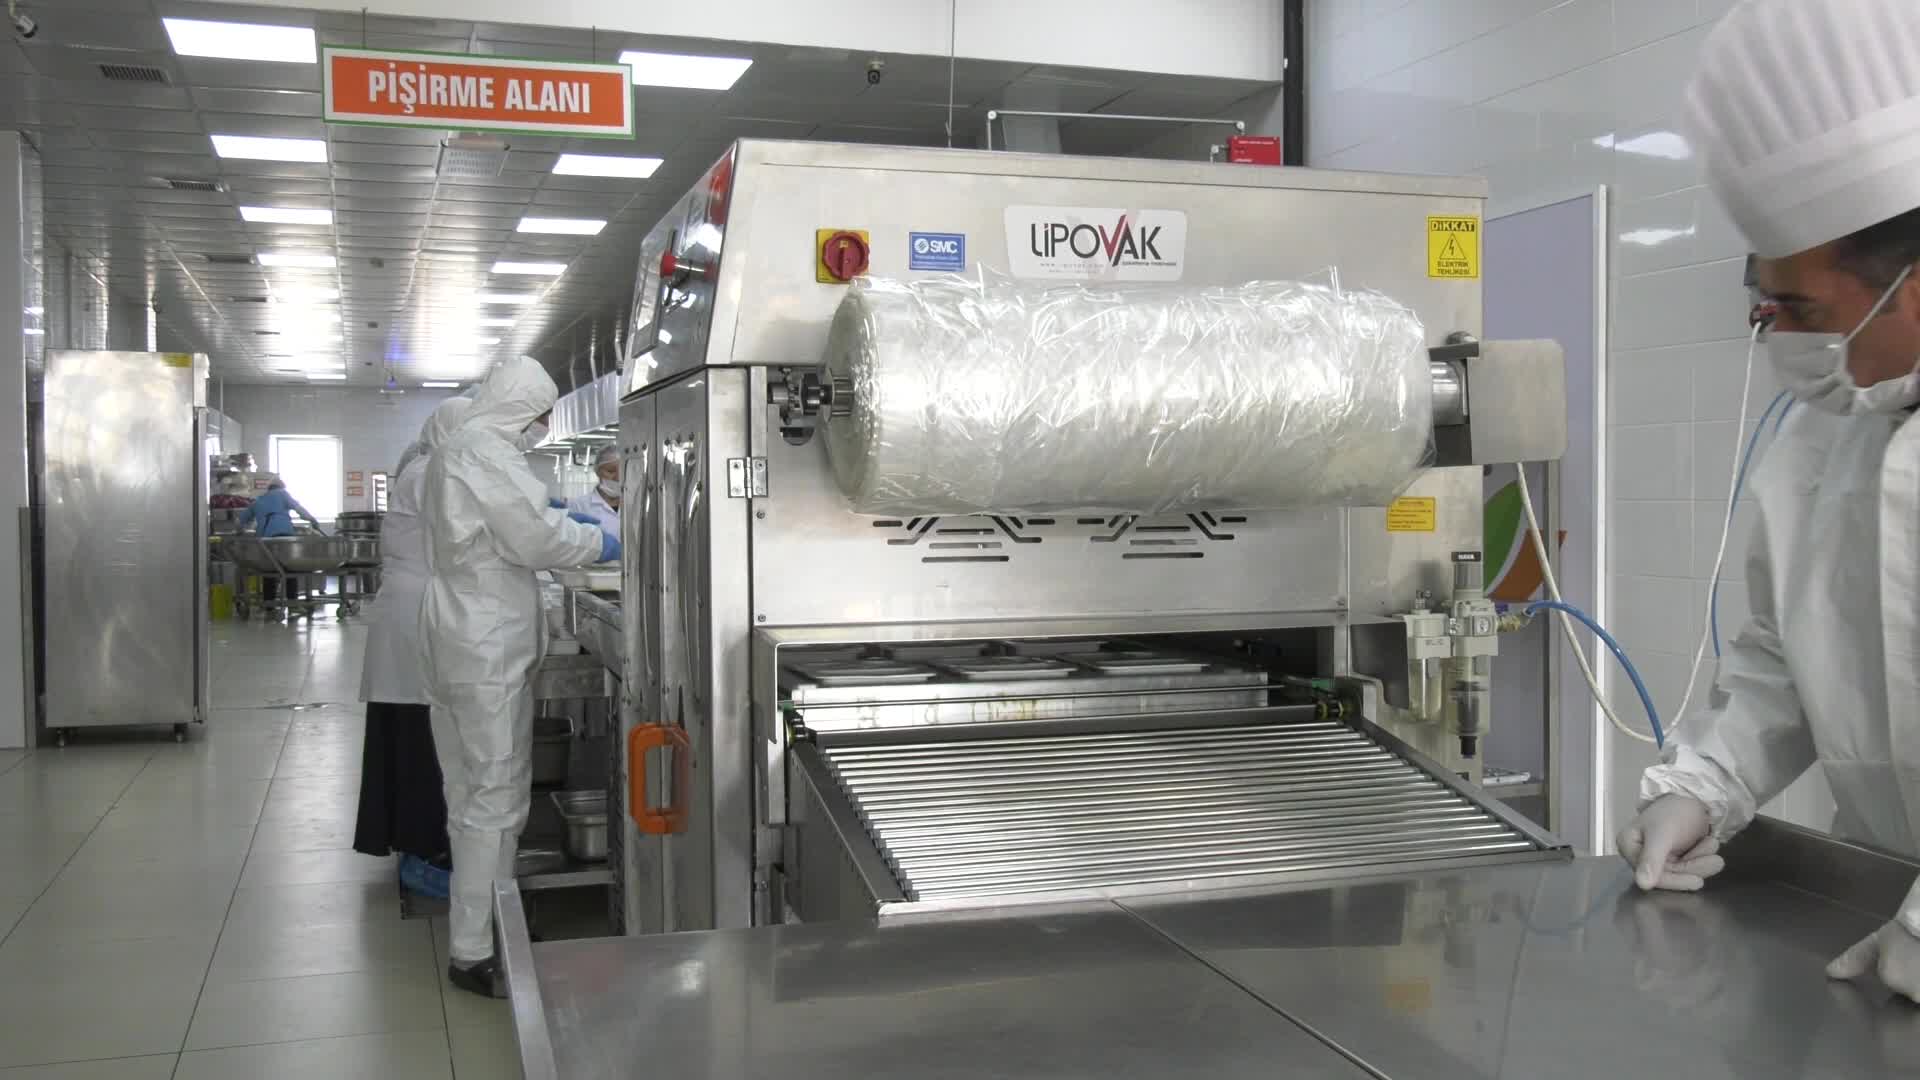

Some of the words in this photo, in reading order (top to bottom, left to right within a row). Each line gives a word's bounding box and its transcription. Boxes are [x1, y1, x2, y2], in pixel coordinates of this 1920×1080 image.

[367, 62, 495, 114] PİŞİRME
[503, 78, 592, 113] ALANI
[930, 240, 957, 253] SMC
